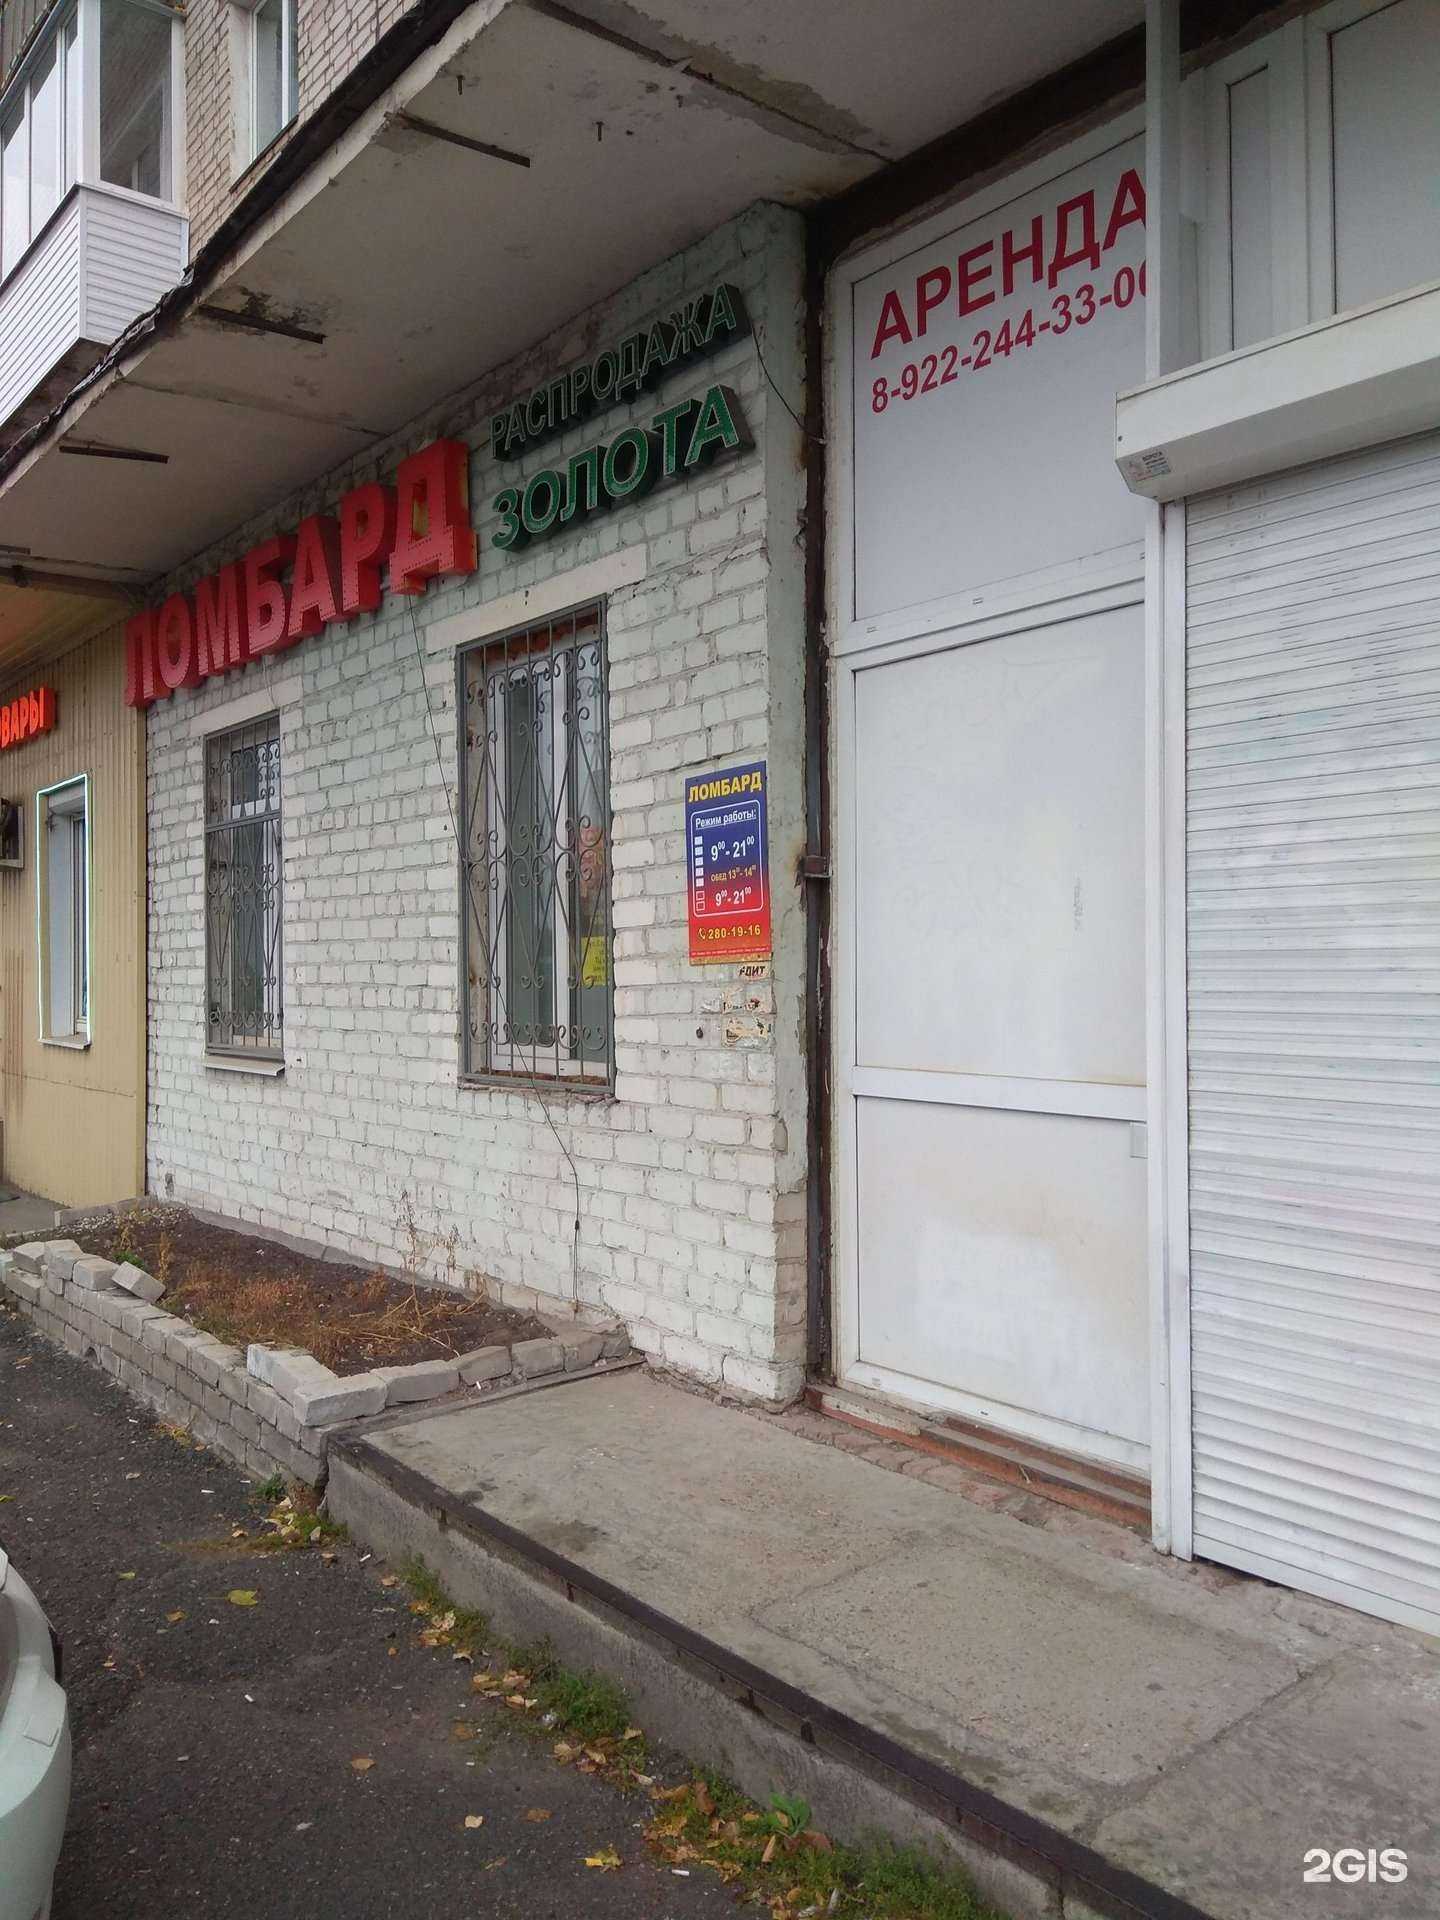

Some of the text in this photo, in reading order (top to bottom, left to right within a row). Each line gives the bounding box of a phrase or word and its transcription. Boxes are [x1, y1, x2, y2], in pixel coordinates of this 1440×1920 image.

[871, 168, 1146, 360] АРЕНДА
[490, 283, 745, 459] РАСПРОДАЖА
[491, 384, 750, 550] ЗОЛОТА
[125, 438, 475, 707] ЛОМБАРД
[0, 685, 47, 749] ВАРЫ
[688, 771, 763, 803] ЛОМБАРД
[695, 809, 757, 829] Режим работы:
[708, 924, 761, 940] 280-19-16
